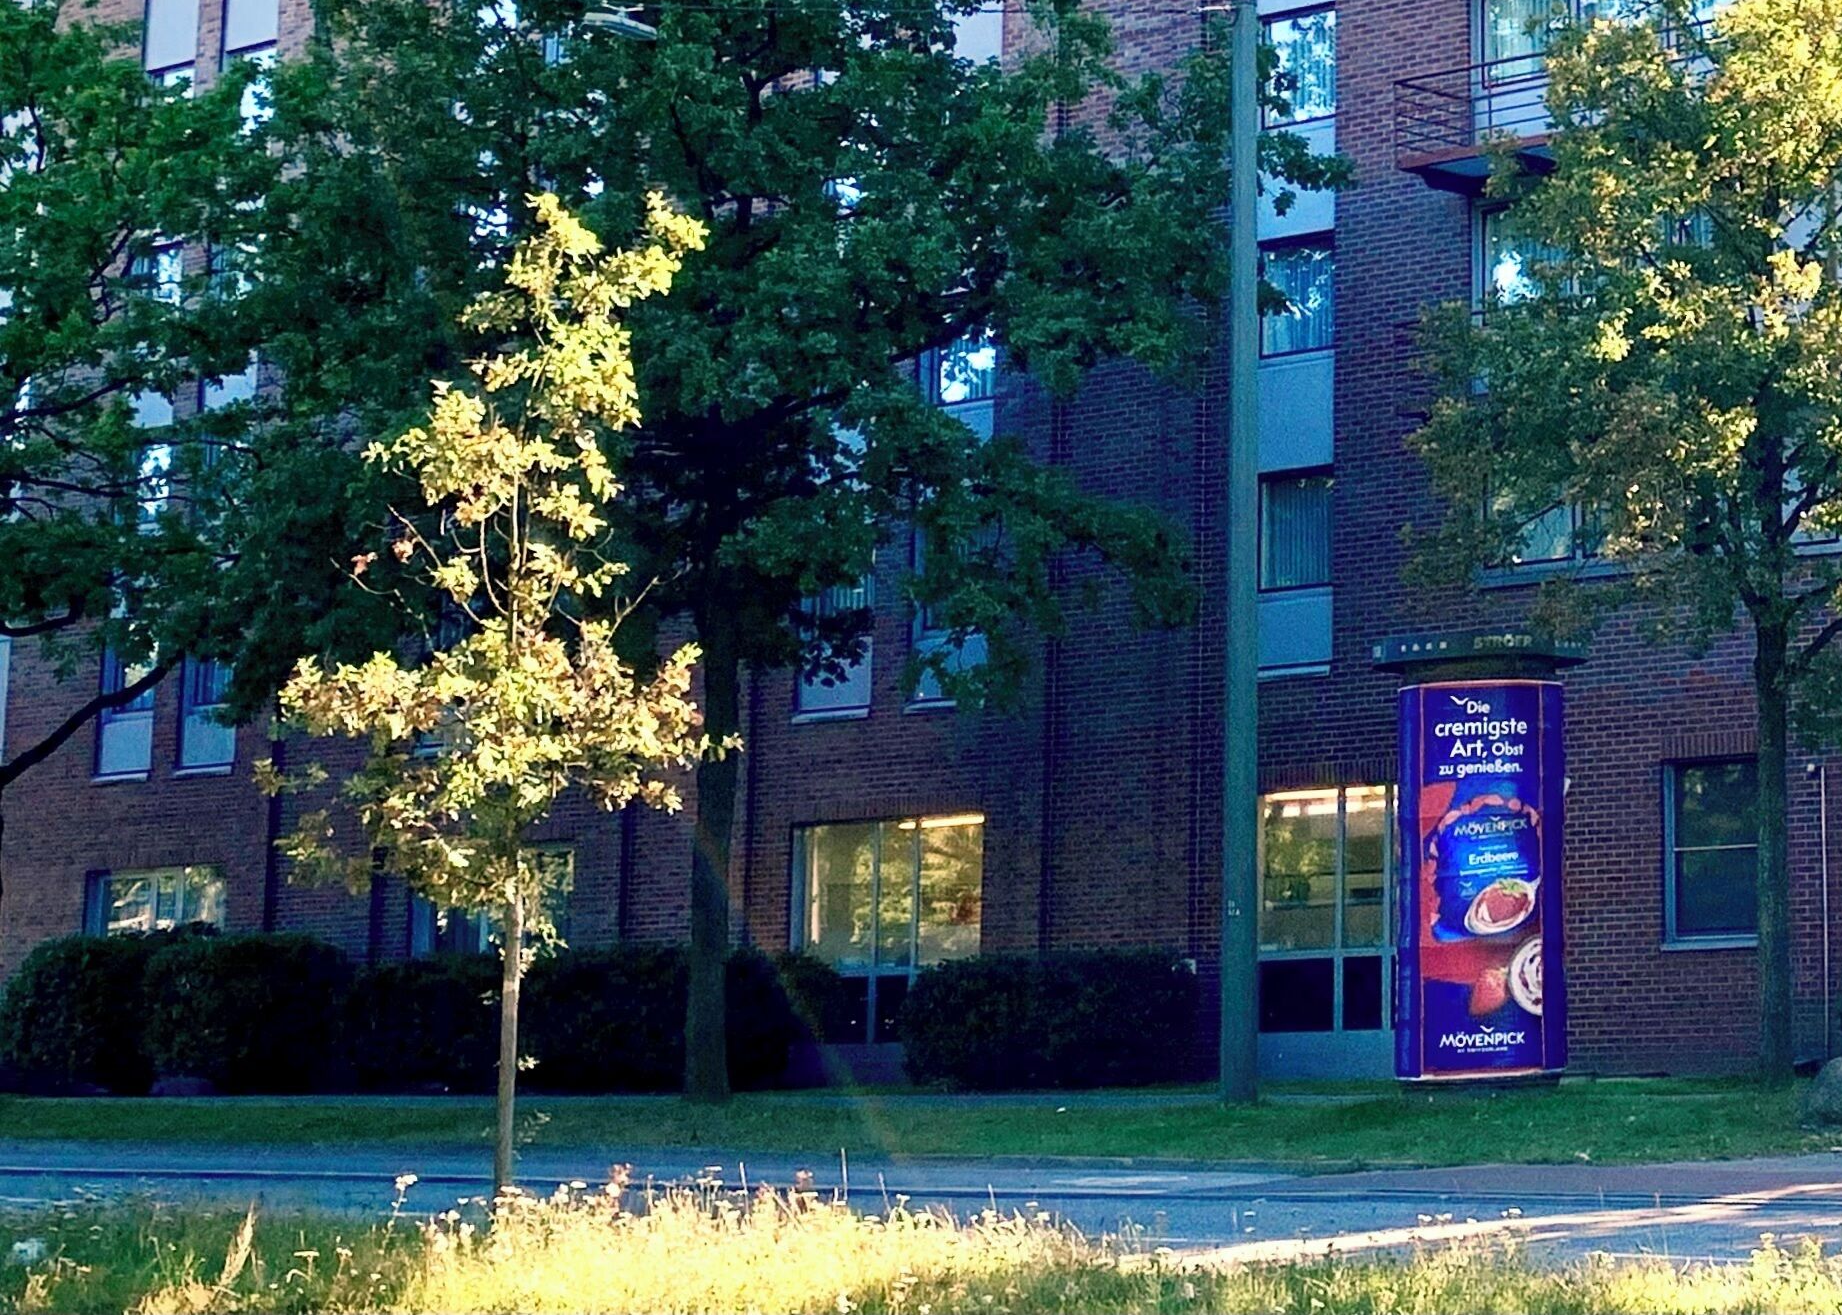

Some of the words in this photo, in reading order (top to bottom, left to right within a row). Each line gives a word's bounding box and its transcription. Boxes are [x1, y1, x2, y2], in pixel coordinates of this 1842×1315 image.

[1466, 699, 1491, 715] Die
[1434, 716, 1528, 740] cremigste
[1449, 738, 1488, 759] Art,
[1491, 740, 1524, 756] Obst
[1438, 764, 1454, 776] zu
[1456, 758, 1524, 779] genießen.
[1439, 1031, 1526, 1048] MÖVENPICK
